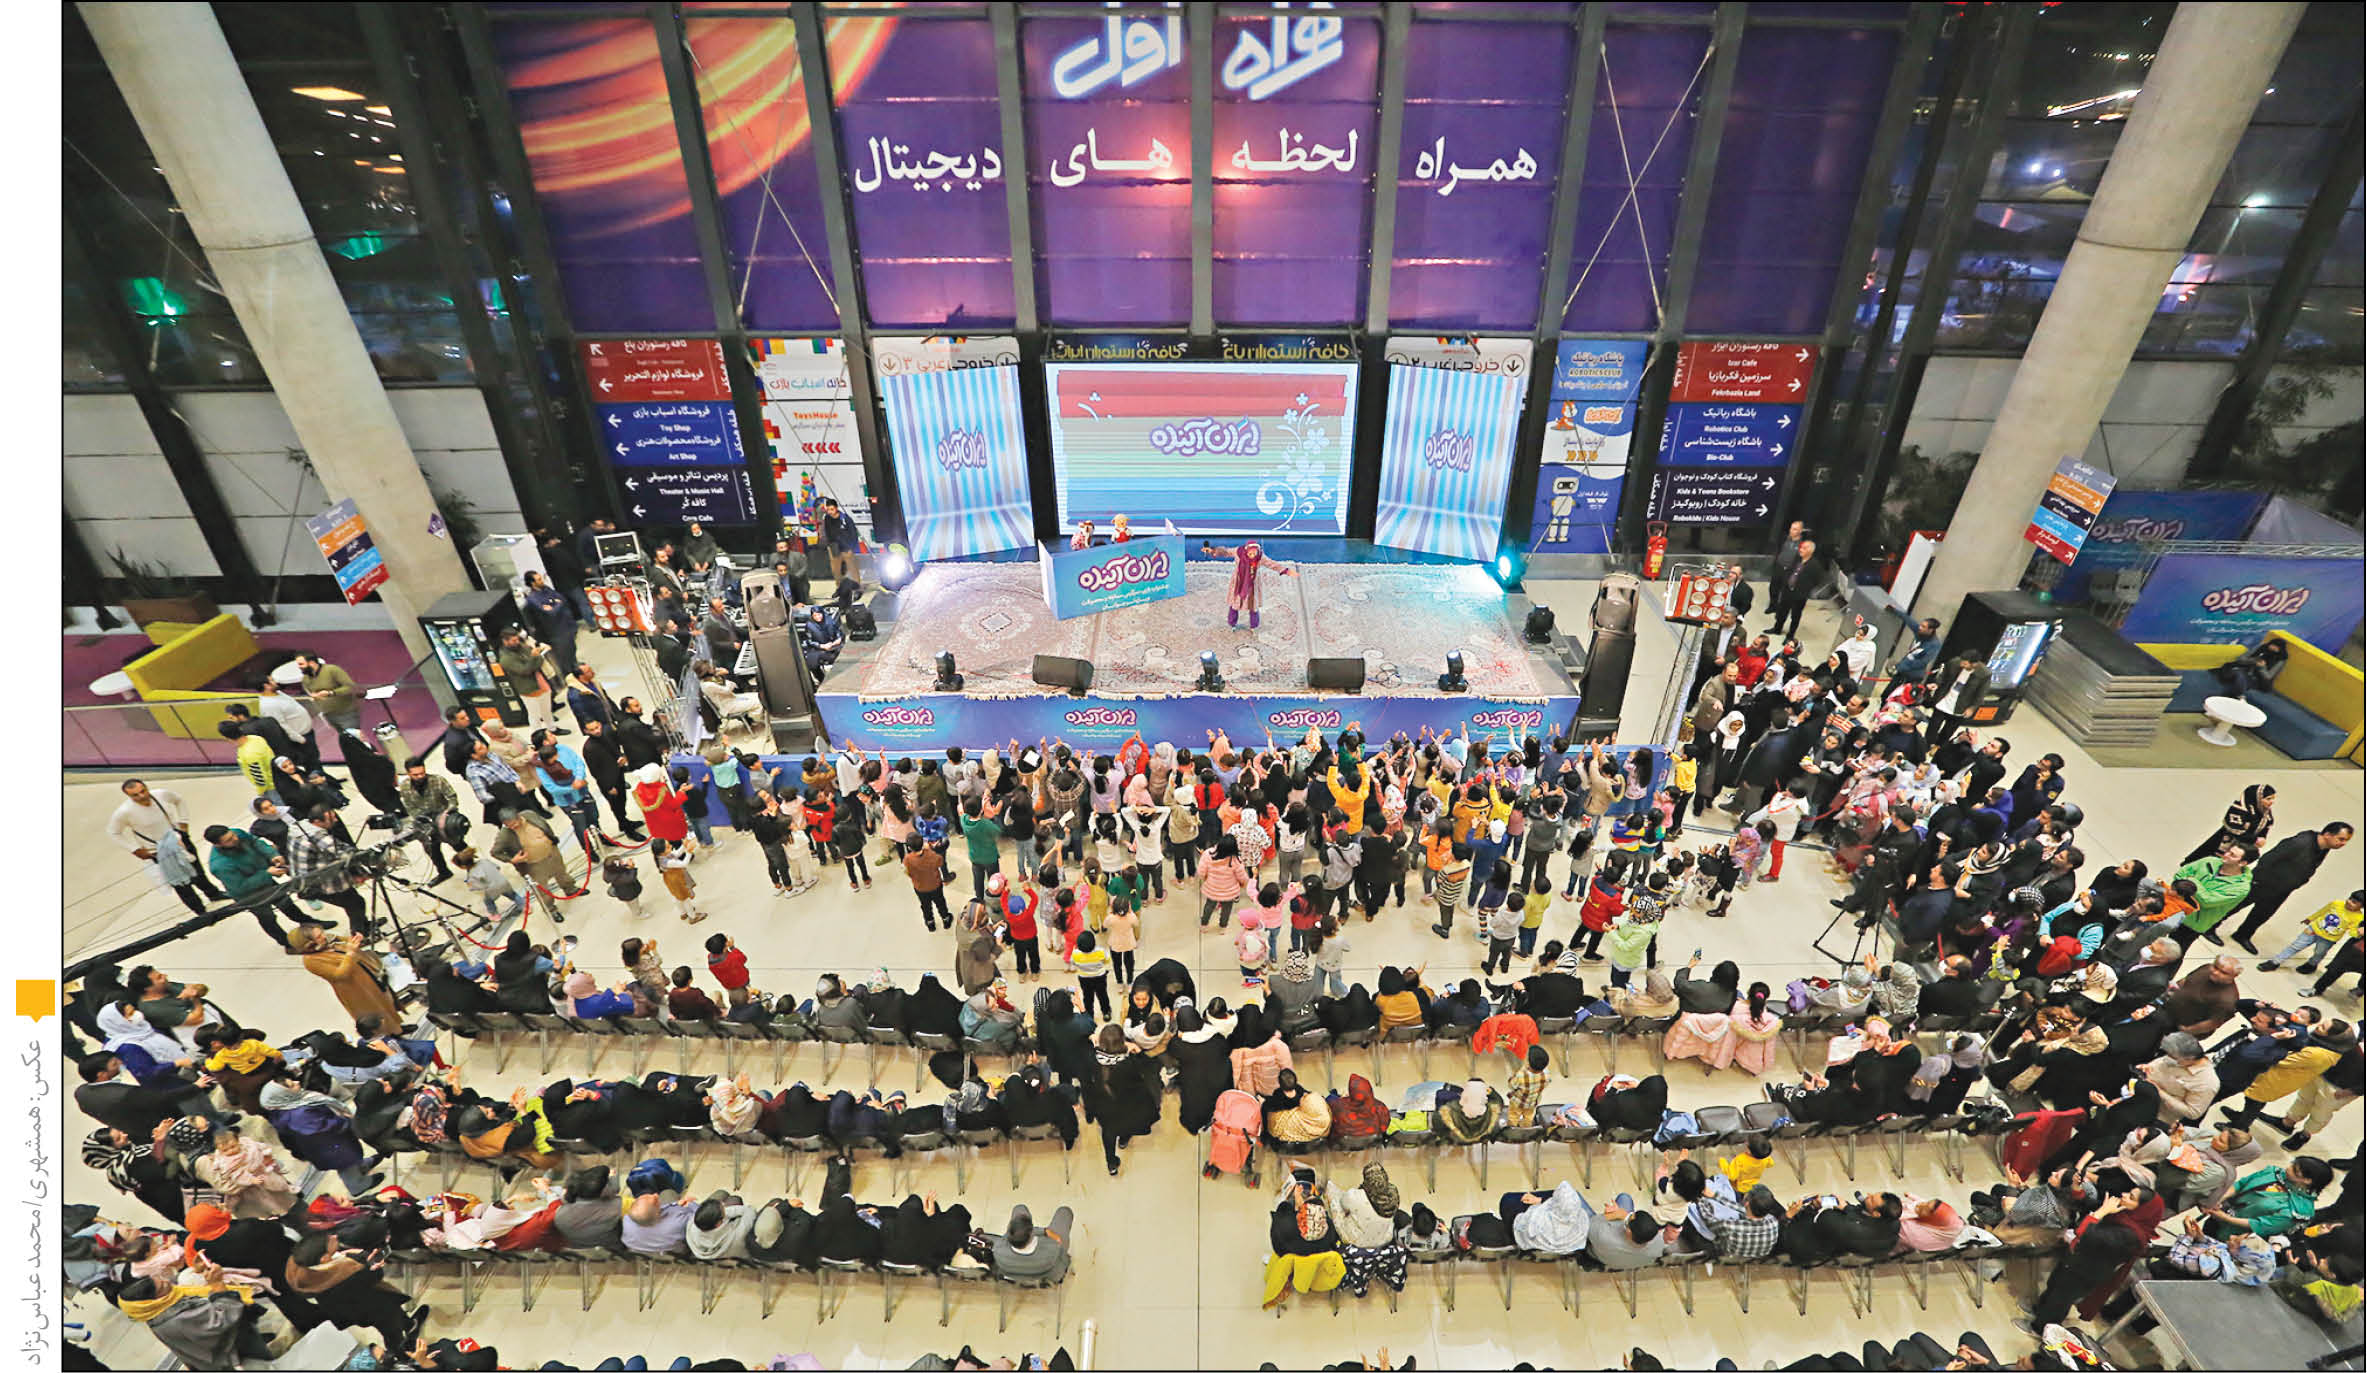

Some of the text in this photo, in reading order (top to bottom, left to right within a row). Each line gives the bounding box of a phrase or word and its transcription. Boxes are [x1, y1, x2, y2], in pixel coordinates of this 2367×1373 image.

[855, 128, 1538, 196] همراه لحظه های دیجیتال
[678, 405, 711, 418] فروشگاه
[1731, 407, 1757, 420] باشگاه
[1150, 413, 1261, 457] ایران آینده
[1736, 436, 1762, 448] باشگاه
[1079, 548, 1170, 592] ایران آینده
[2202, 584, 2312, 615] ایران آینده
[862, 706, 935, 726] ایران آینده
[1064, 706, 1137, 727] ایران آینده
[1269, 708, 1341, 728] ایران آینده
[1472, 708, 1515, 729] آینده
